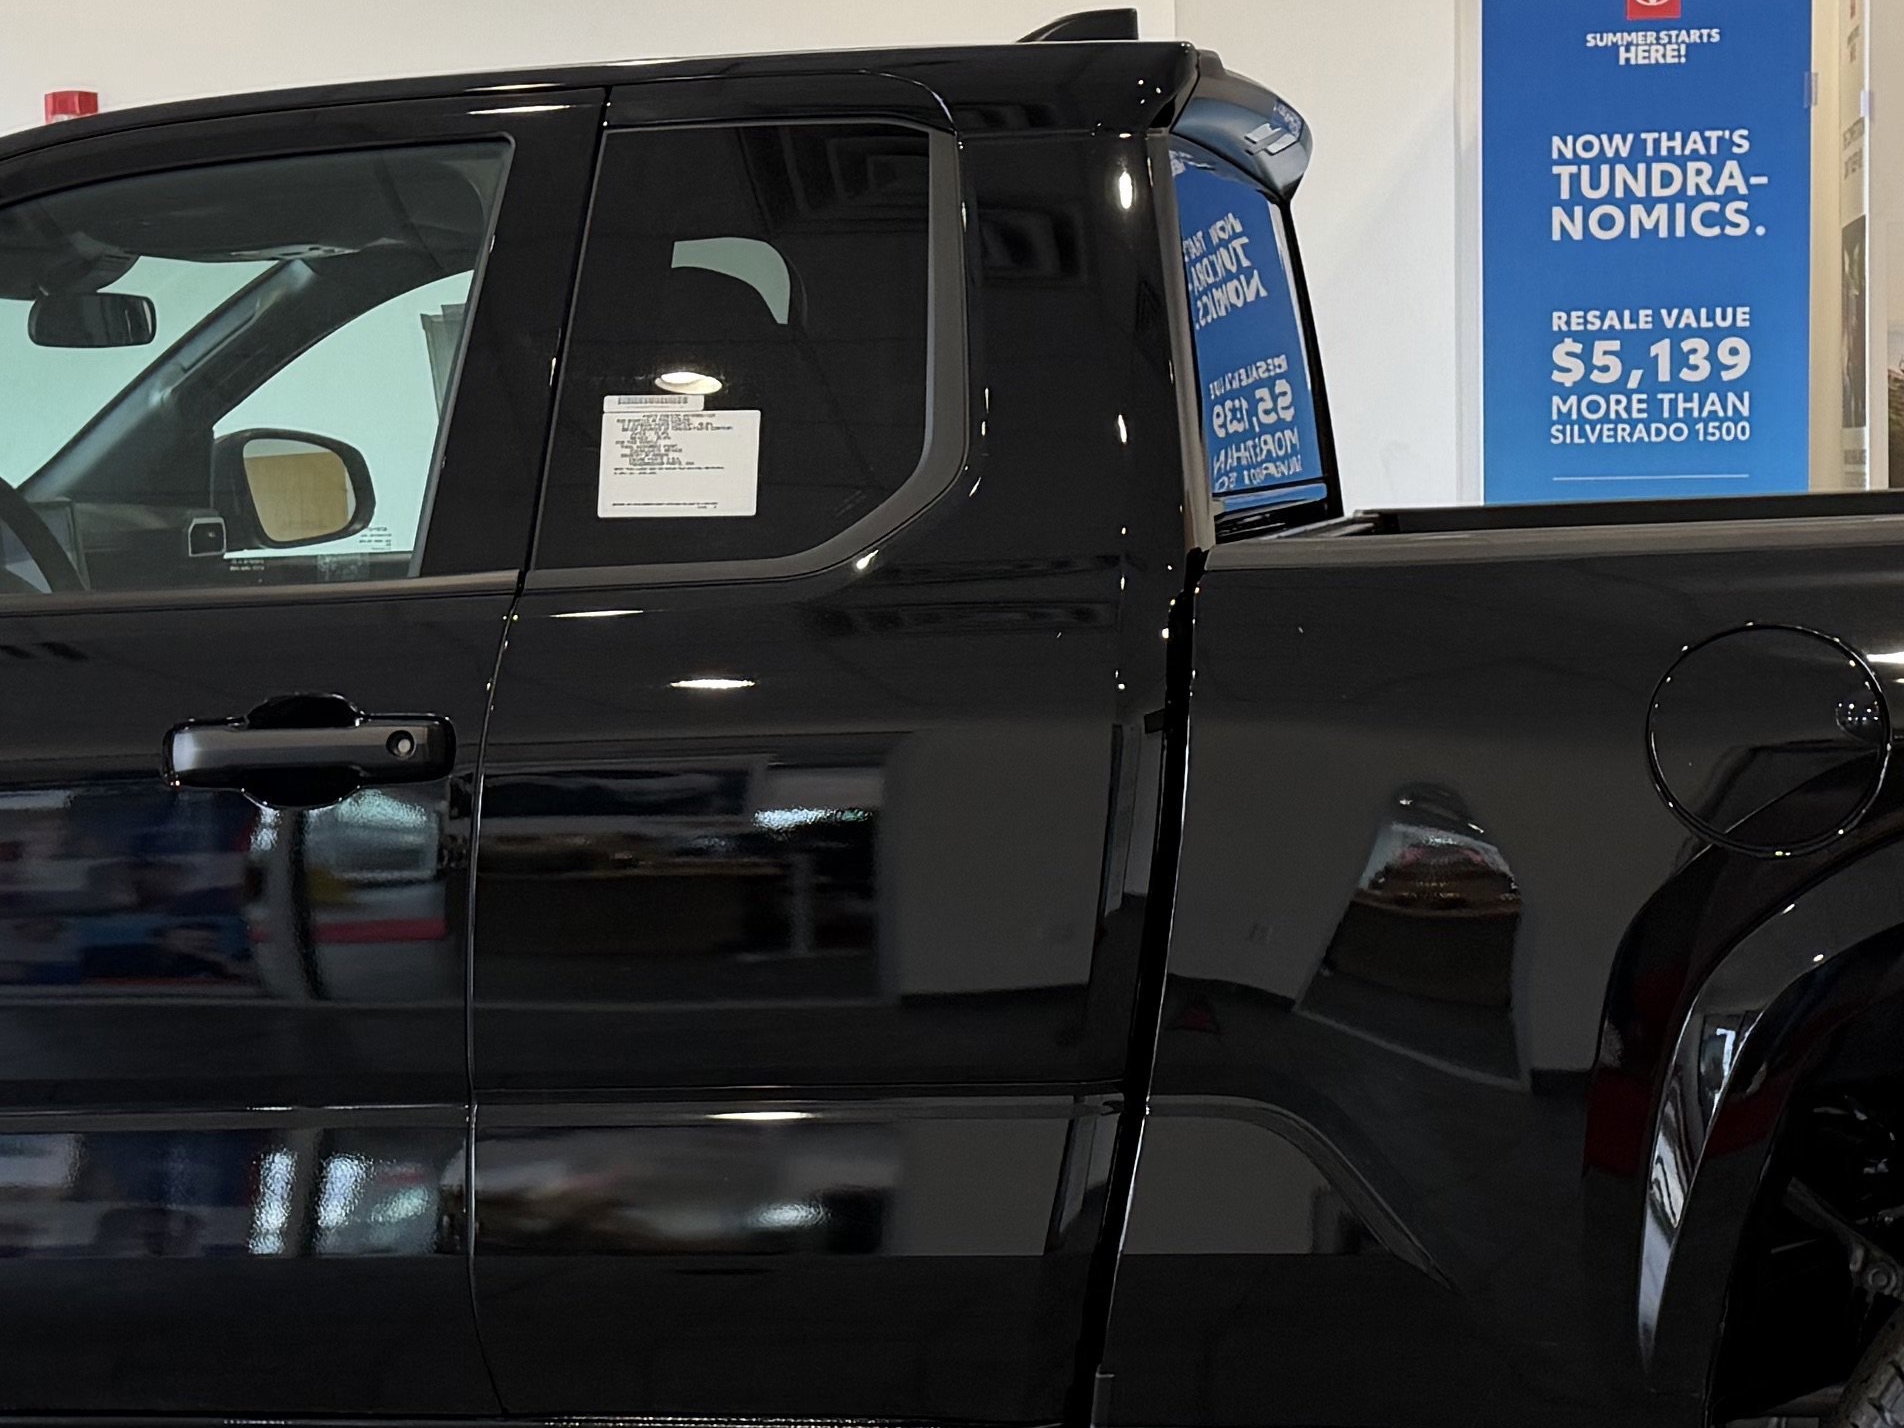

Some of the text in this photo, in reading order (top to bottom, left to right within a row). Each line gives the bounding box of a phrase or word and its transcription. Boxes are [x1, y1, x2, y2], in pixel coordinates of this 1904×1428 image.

[1585, 28, 1721, 47] SUMMER STARTS
[1618, 43, 1687, 65] HERE!
[1551, 129, 1750, 160] NOW THAT'S
[1551, 159, 1769, 200] TUNDRA-
[1551, 200, 1766, 241] NOMICS.
[1551, 306, 1751, 331] RESALE VALUE
[1550, 336, 1752, 389] $5,139
[1551, 391, 1750, 420] MORE THAN
[1550, 421, 1751, 444] SILVERADO 1500
